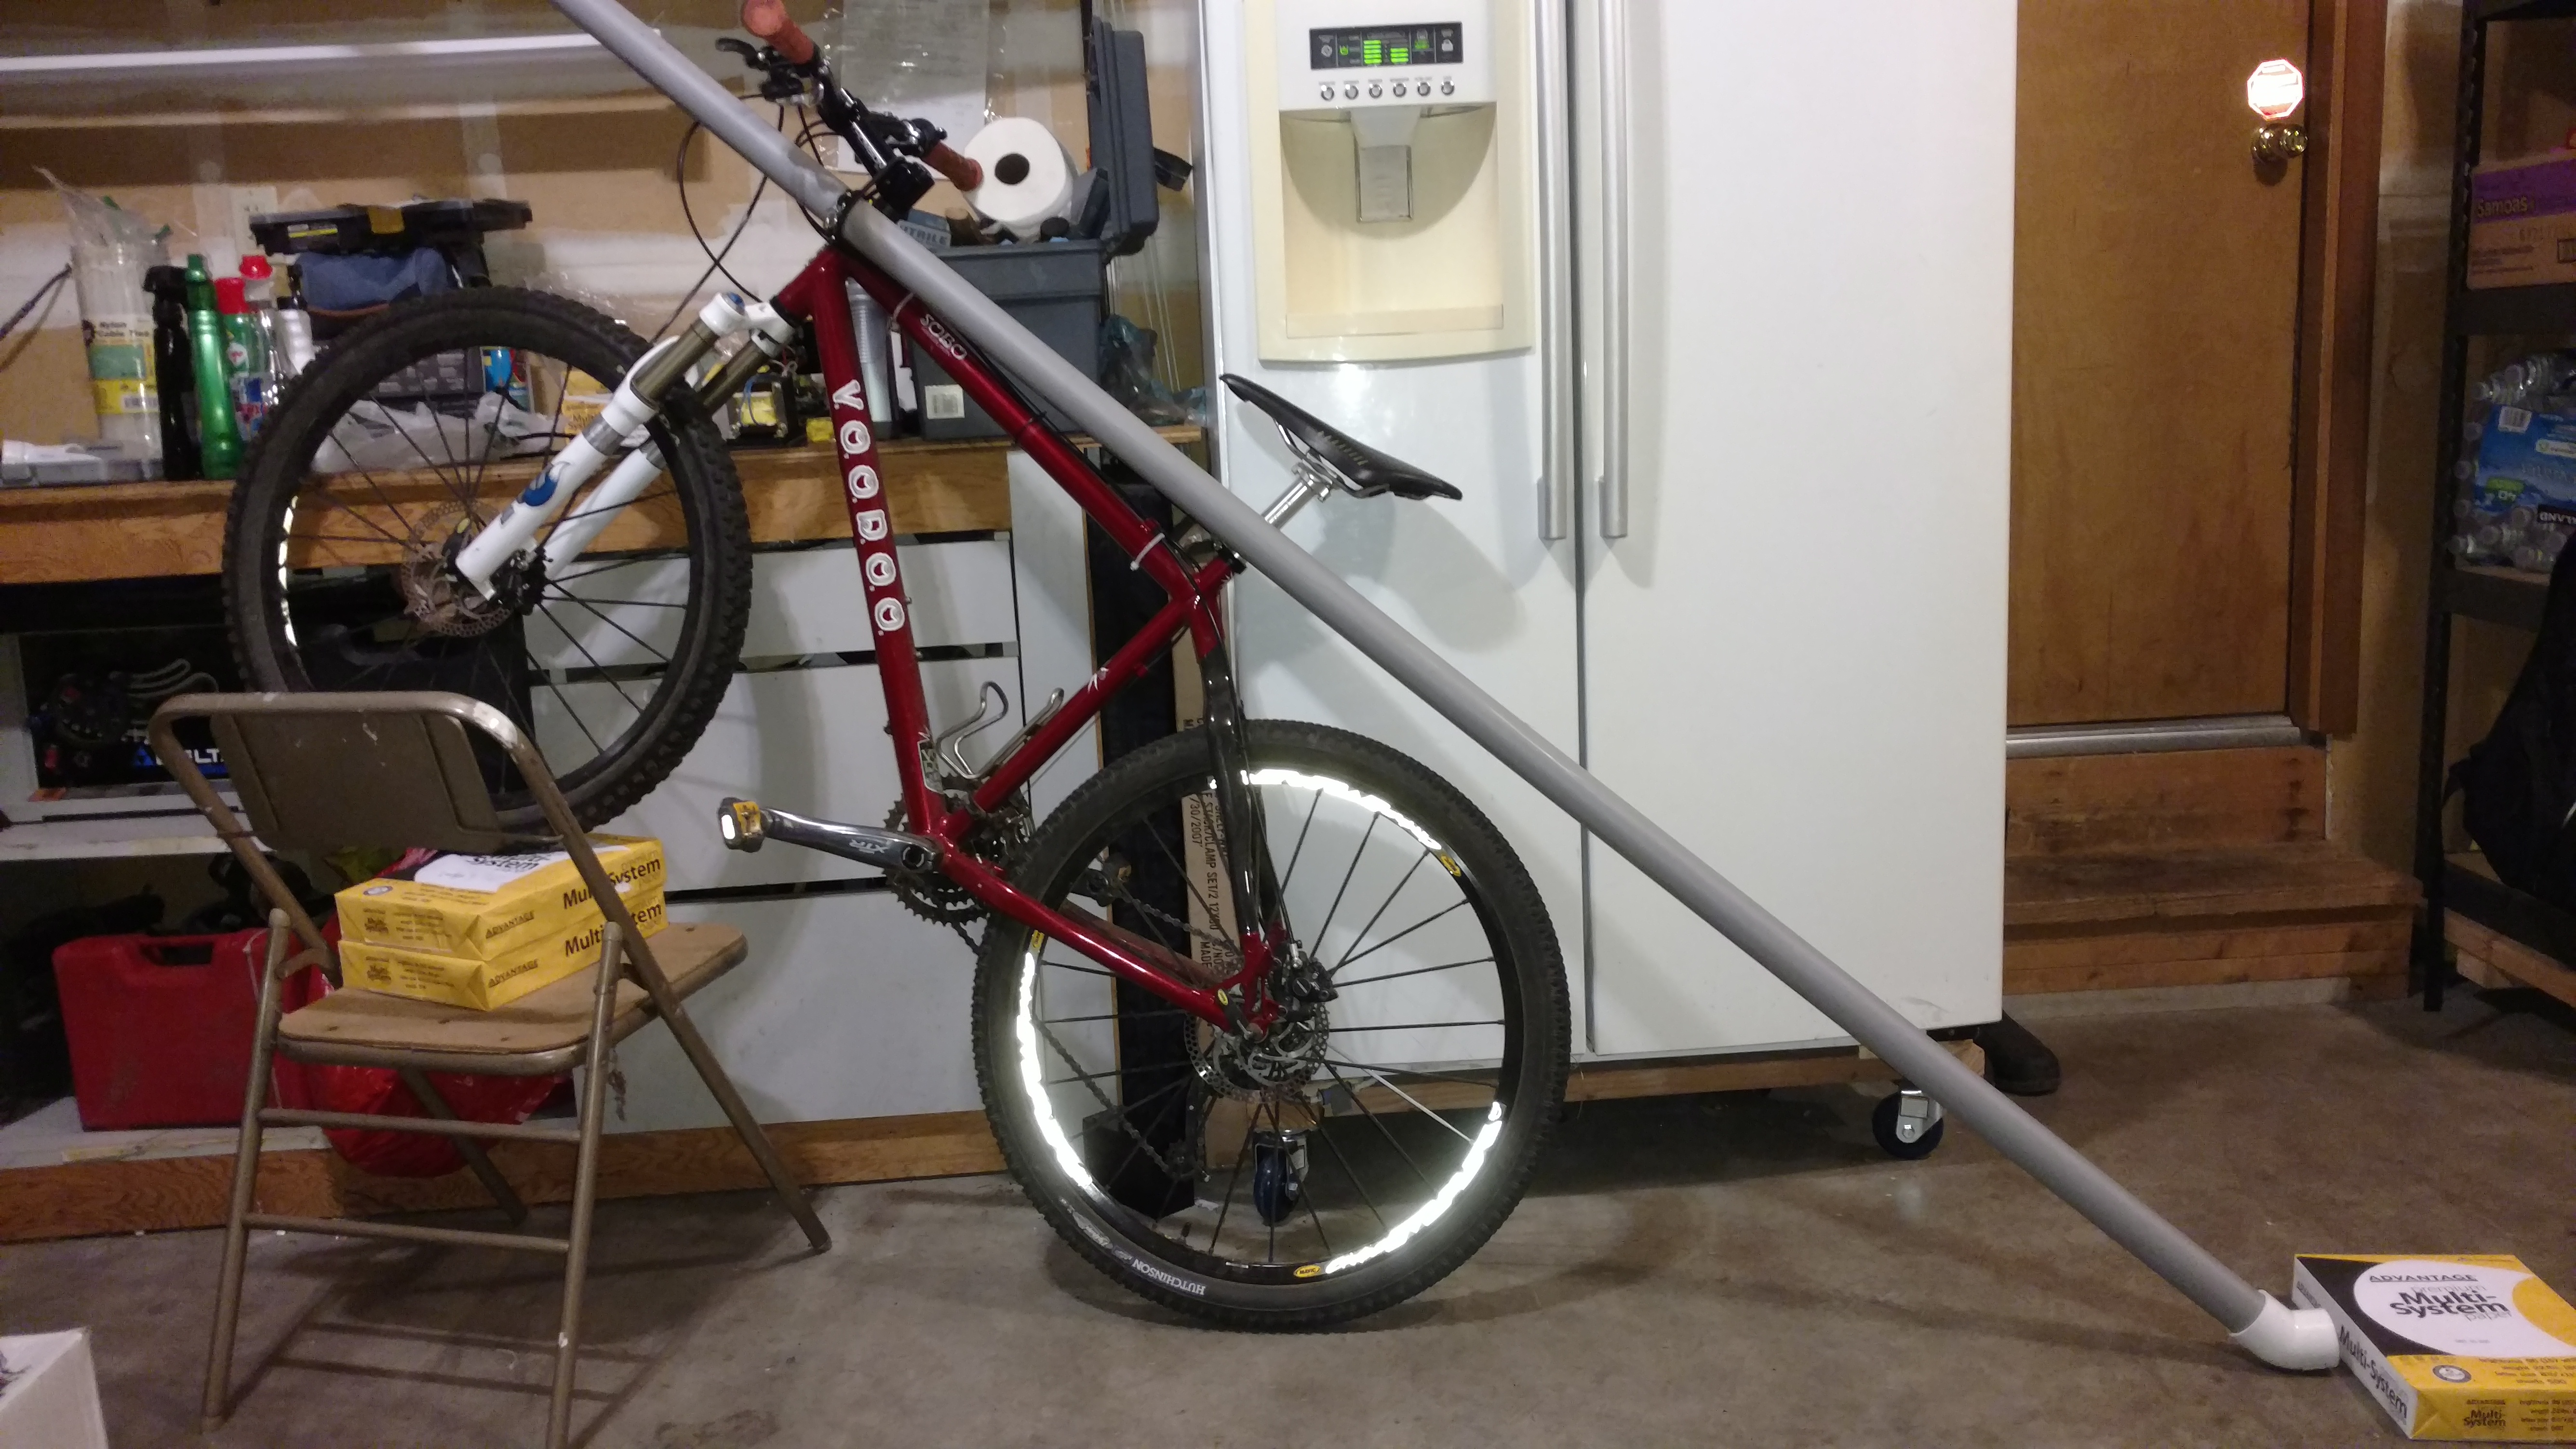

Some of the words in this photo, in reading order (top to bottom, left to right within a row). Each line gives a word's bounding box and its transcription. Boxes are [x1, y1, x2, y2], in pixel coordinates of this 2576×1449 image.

[2477, 195, 2528, 218] Samoas
[920, 313, 967, 361] SOBO
[485, 910, 535, 939] ADVANTAGE
[488, 958, 539, 988] ADVANTAGE
[1132, 1258, 1206, 1296] HUTCHINSON
[2369, 1274, 2478, 1283] ADVANTAGE
[2389, 1301, 2509, 1318] System
[2399, 1290, 2497, 1305] Multi-
